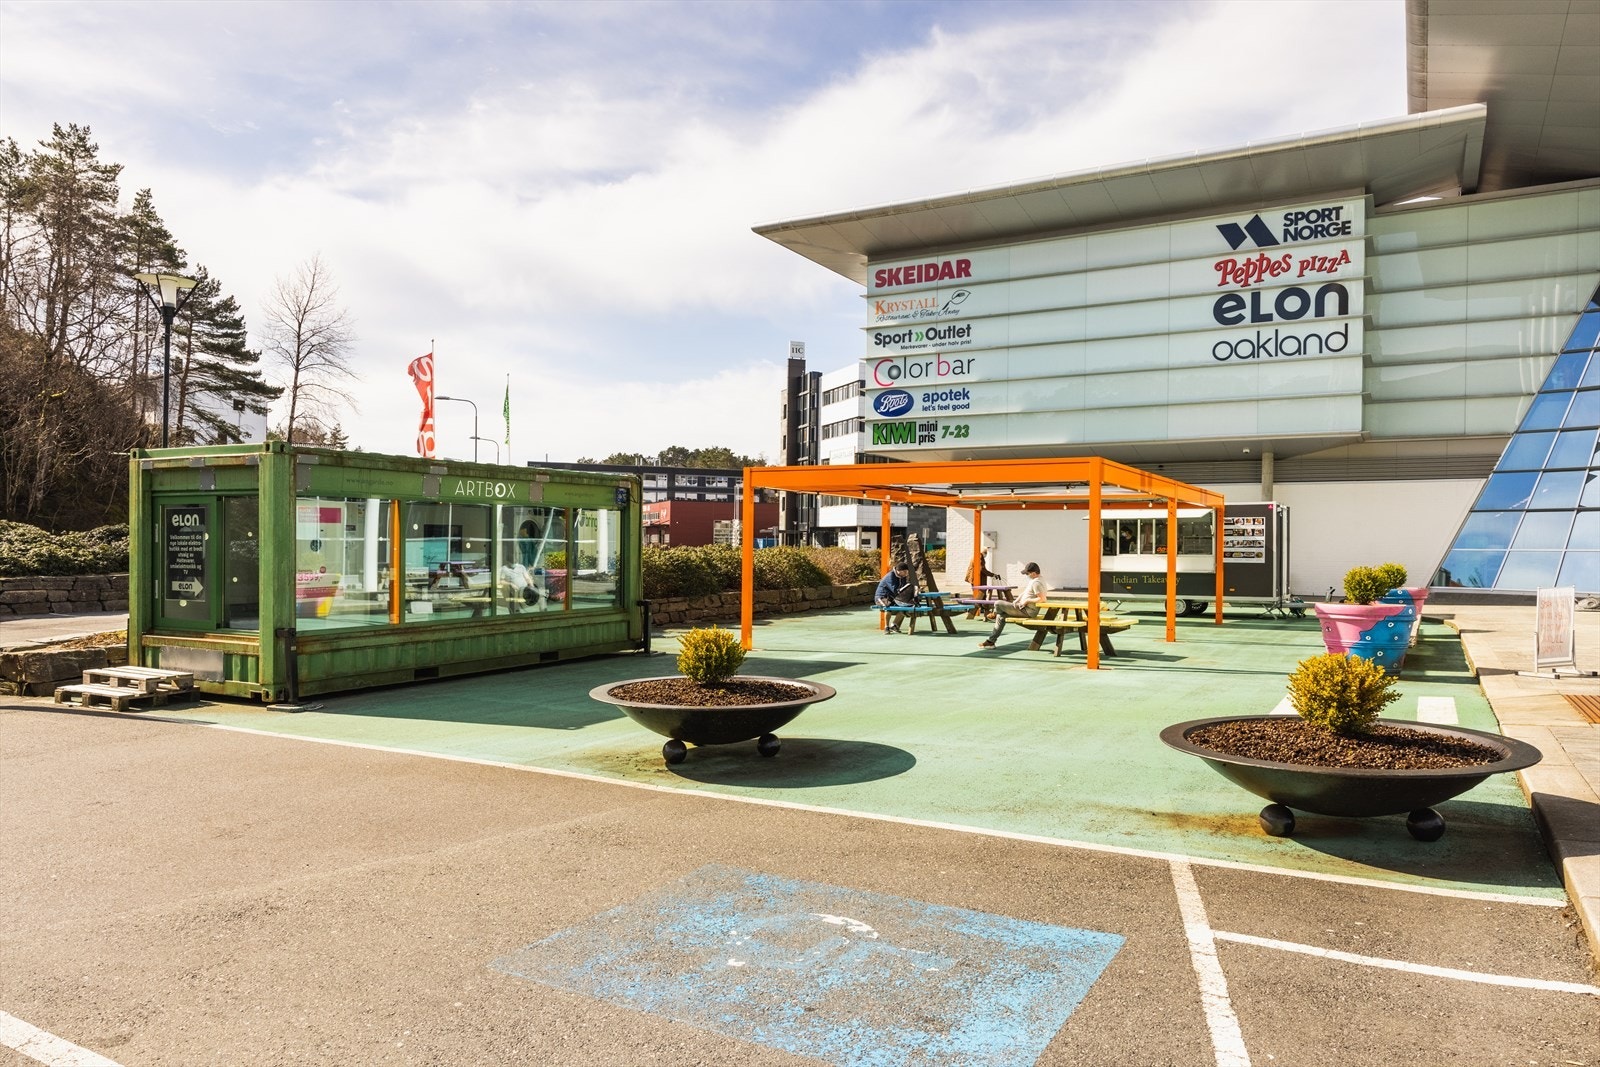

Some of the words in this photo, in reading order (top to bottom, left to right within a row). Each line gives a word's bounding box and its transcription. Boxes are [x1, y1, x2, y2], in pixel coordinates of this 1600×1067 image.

[1283, 206, 1344, 228] SPORT
[1283, 220, 1352, 242] NORGE
[875, 259, 972, 289] SKEIDAR
[1214, 253, 1292, 288] Peppes
[874, 329, 913, 348] Sport
[925, 324, 972, 341] Outlet
[1212, 323, 1348, 361] oakland
[877, 393, 908, 413] Boots
[922, 387, 970, 404] apotek
[937, 403, 950, 411] feel
[951, 403, 970, 411] good
[873, 421, 917, 445] KIWI
[918, 421, 938, 432] mini
[941, 424, 970, 439] 7-23
[918, 432, 936, 445] pris
[455, 480, 515, 498] ARTBOX
[1112, 575, 1138, 584] Indian
[1142, 575, 1181, 586] Takeay
